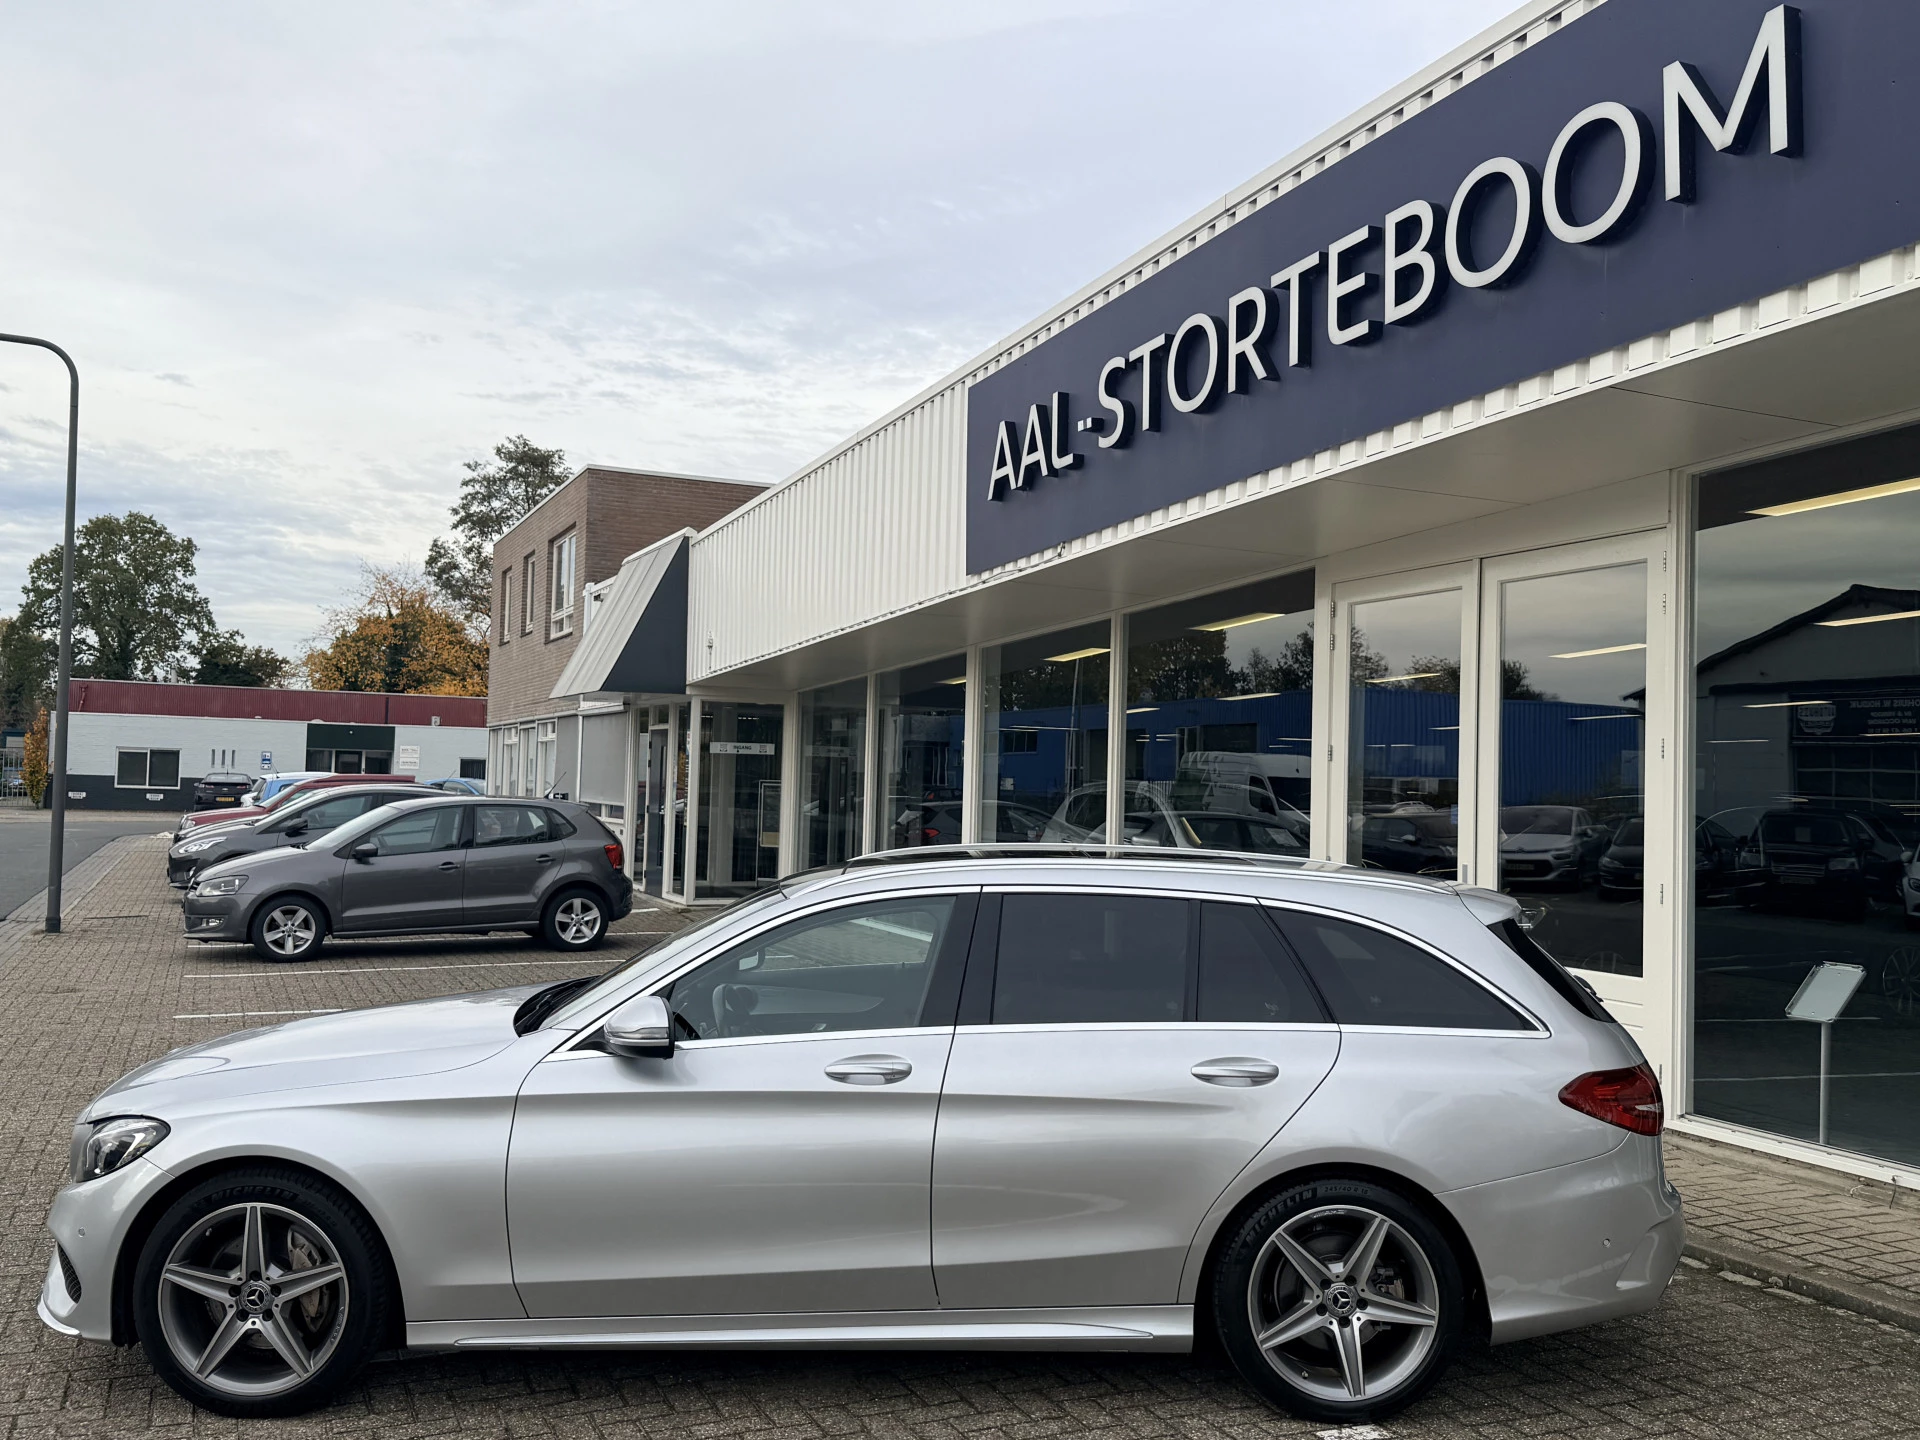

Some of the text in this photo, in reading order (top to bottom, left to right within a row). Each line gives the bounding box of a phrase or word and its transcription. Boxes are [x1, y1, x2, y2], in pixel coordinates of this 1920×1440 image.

[988, 4, 1802, 501] AAL-STORTEBOOM
[212, 1186, 295, 1201] MICHELIN
[1246, 1189, 1313, 1244] MICHELIN
